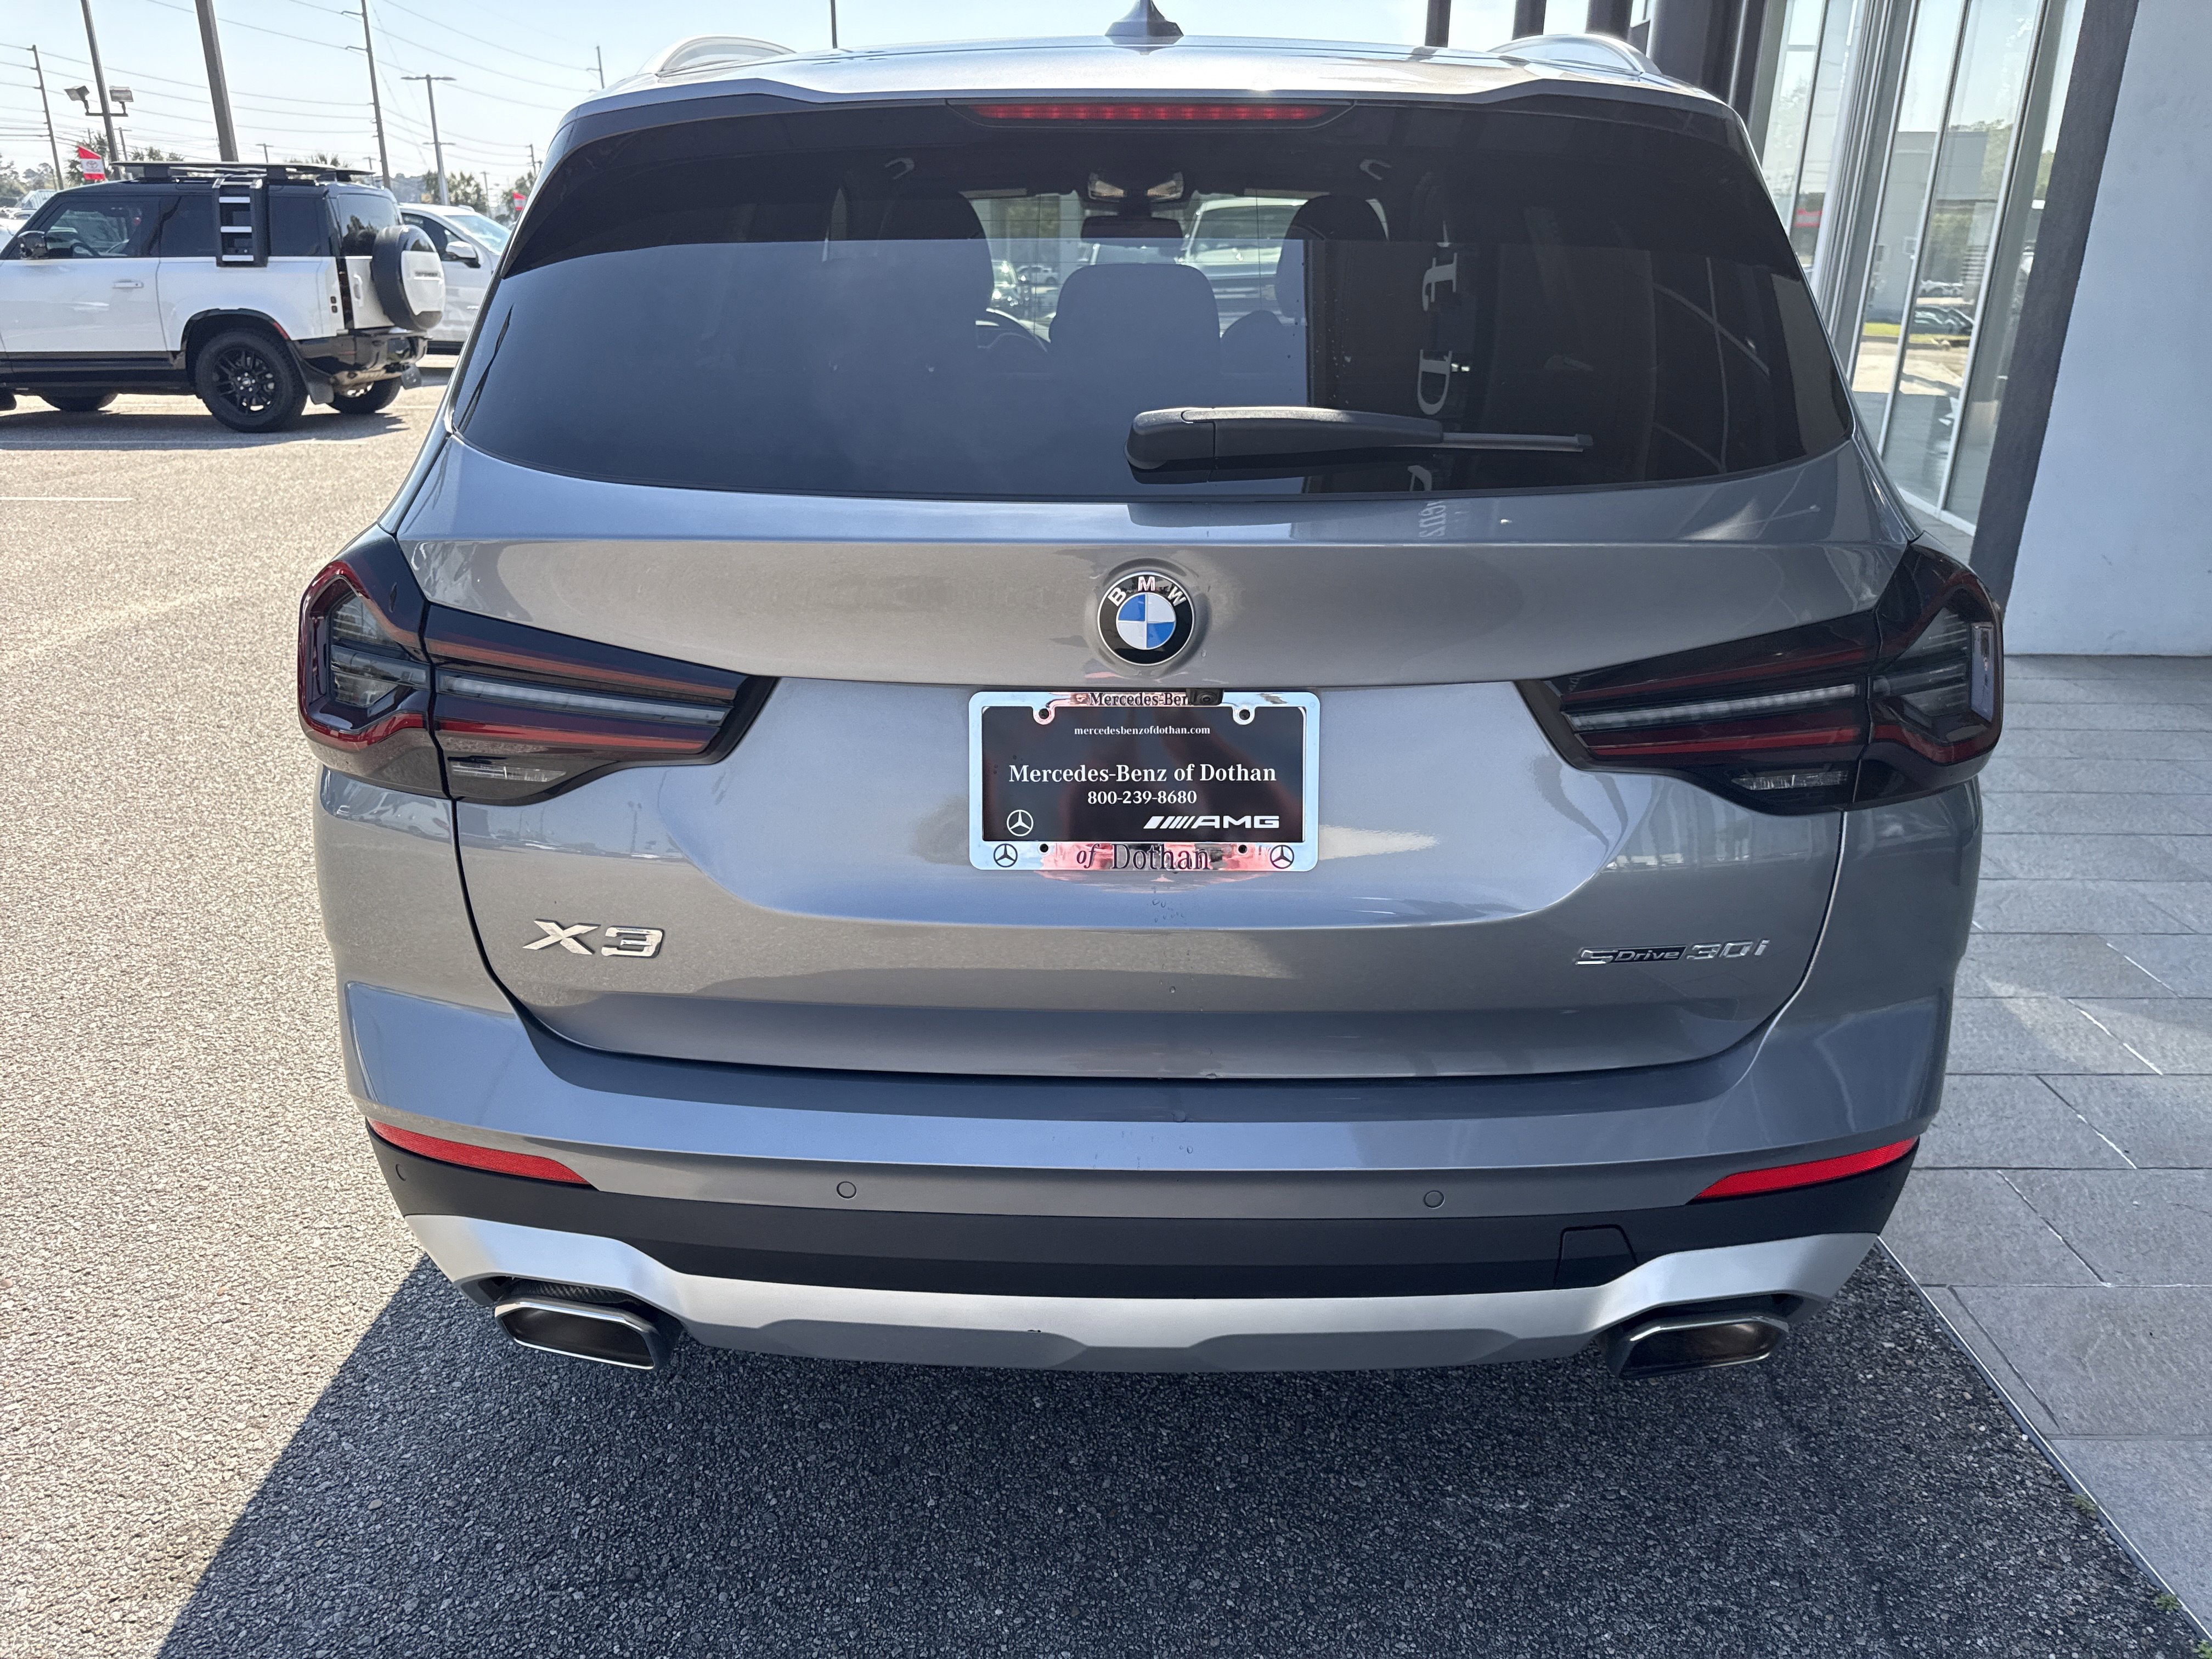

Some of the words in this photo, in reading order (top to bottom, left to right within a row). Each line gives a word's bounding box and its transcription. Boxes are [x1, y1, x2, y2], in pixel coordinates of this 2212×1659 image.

[1107, 576, 1187, 607] BMW
[1090, 692, 1188, 706] Mercedes-Ben
[1074, 725, 1211, 735] mercedesbenzofdothan.com
[1008, 765, 1167, 782] Mercedes-Benz
[1174, 764, 1195, 782] of
[1200, 764, 1277, 782] Dothan
[1087, 790, 1197, 804] 800-239-8680
[1191, 815, 1279, 829] AMG
[1076, 843, 1099, 868] of
[1111, 843, 1211, 870] Dothan
[522, 918, 664, 958] X3
